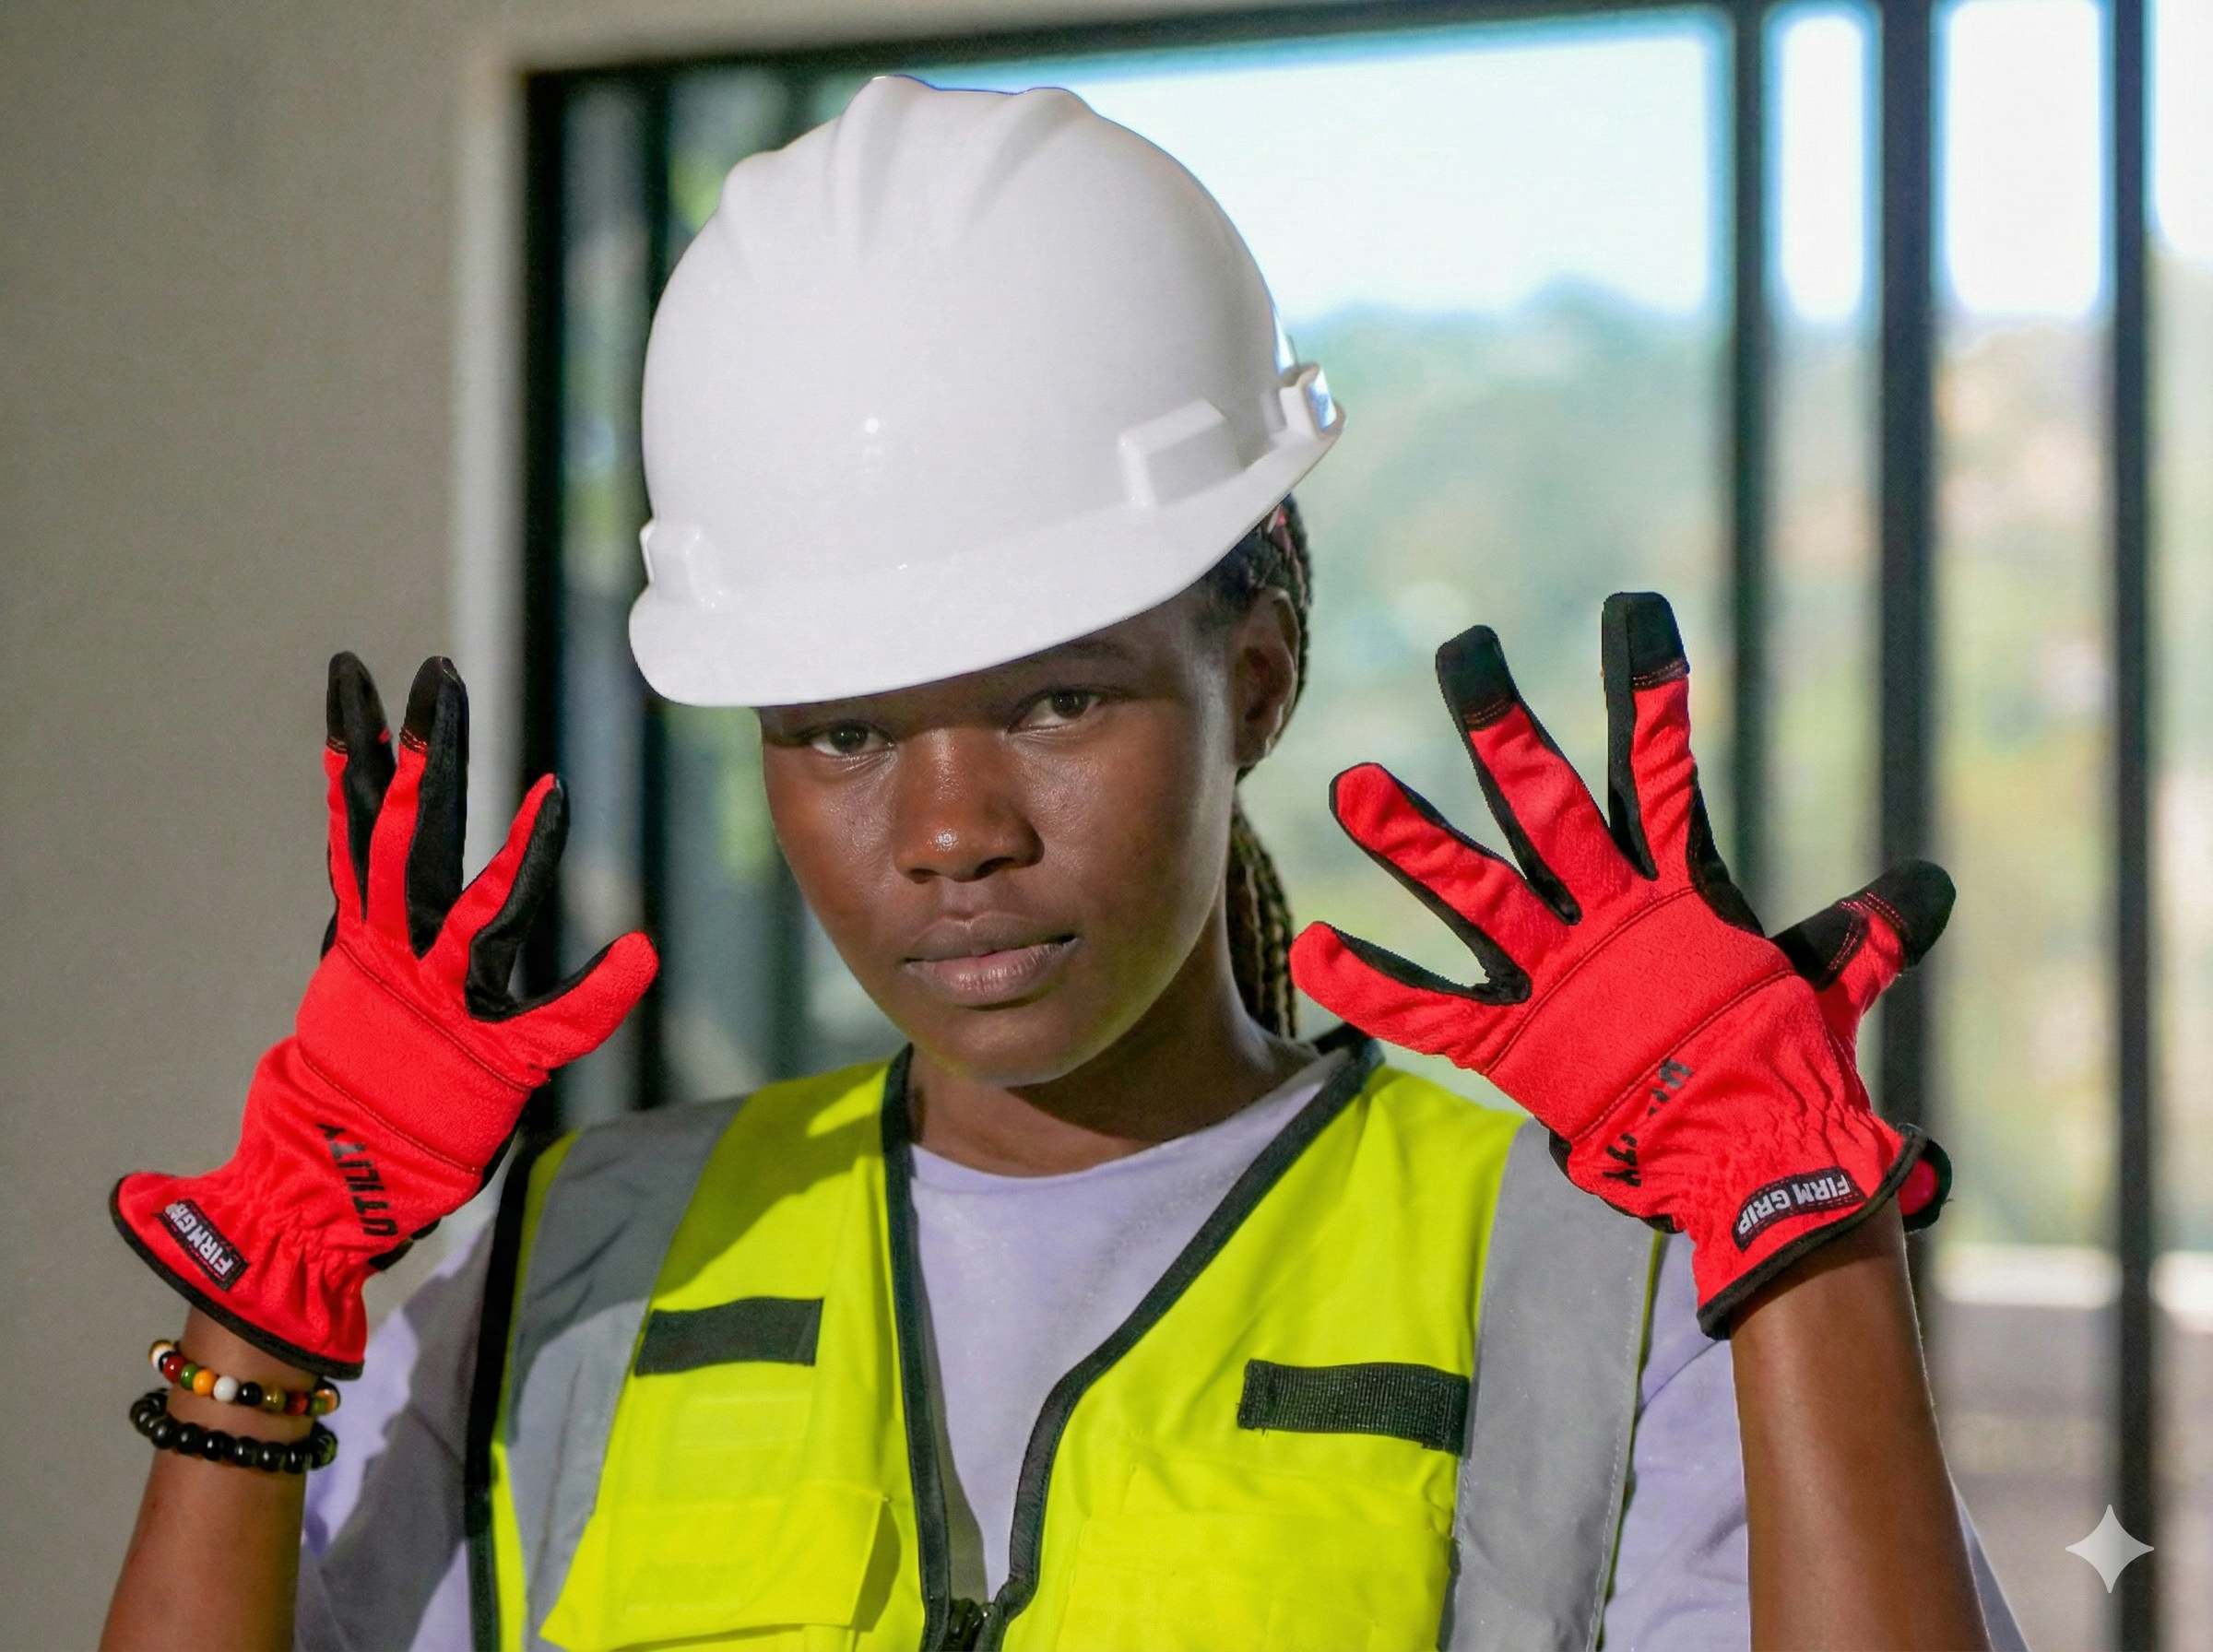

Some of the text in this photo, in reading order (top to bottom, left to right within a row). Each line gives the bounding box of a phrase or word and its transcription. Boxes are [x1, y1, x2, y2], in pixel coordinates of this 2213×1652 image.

[316, 1124, 399, 1236] UTILITY
[1737, 1174, 1852, 1235] FIRM GRIP
[186, 1229, 234, 1276] FIRM
